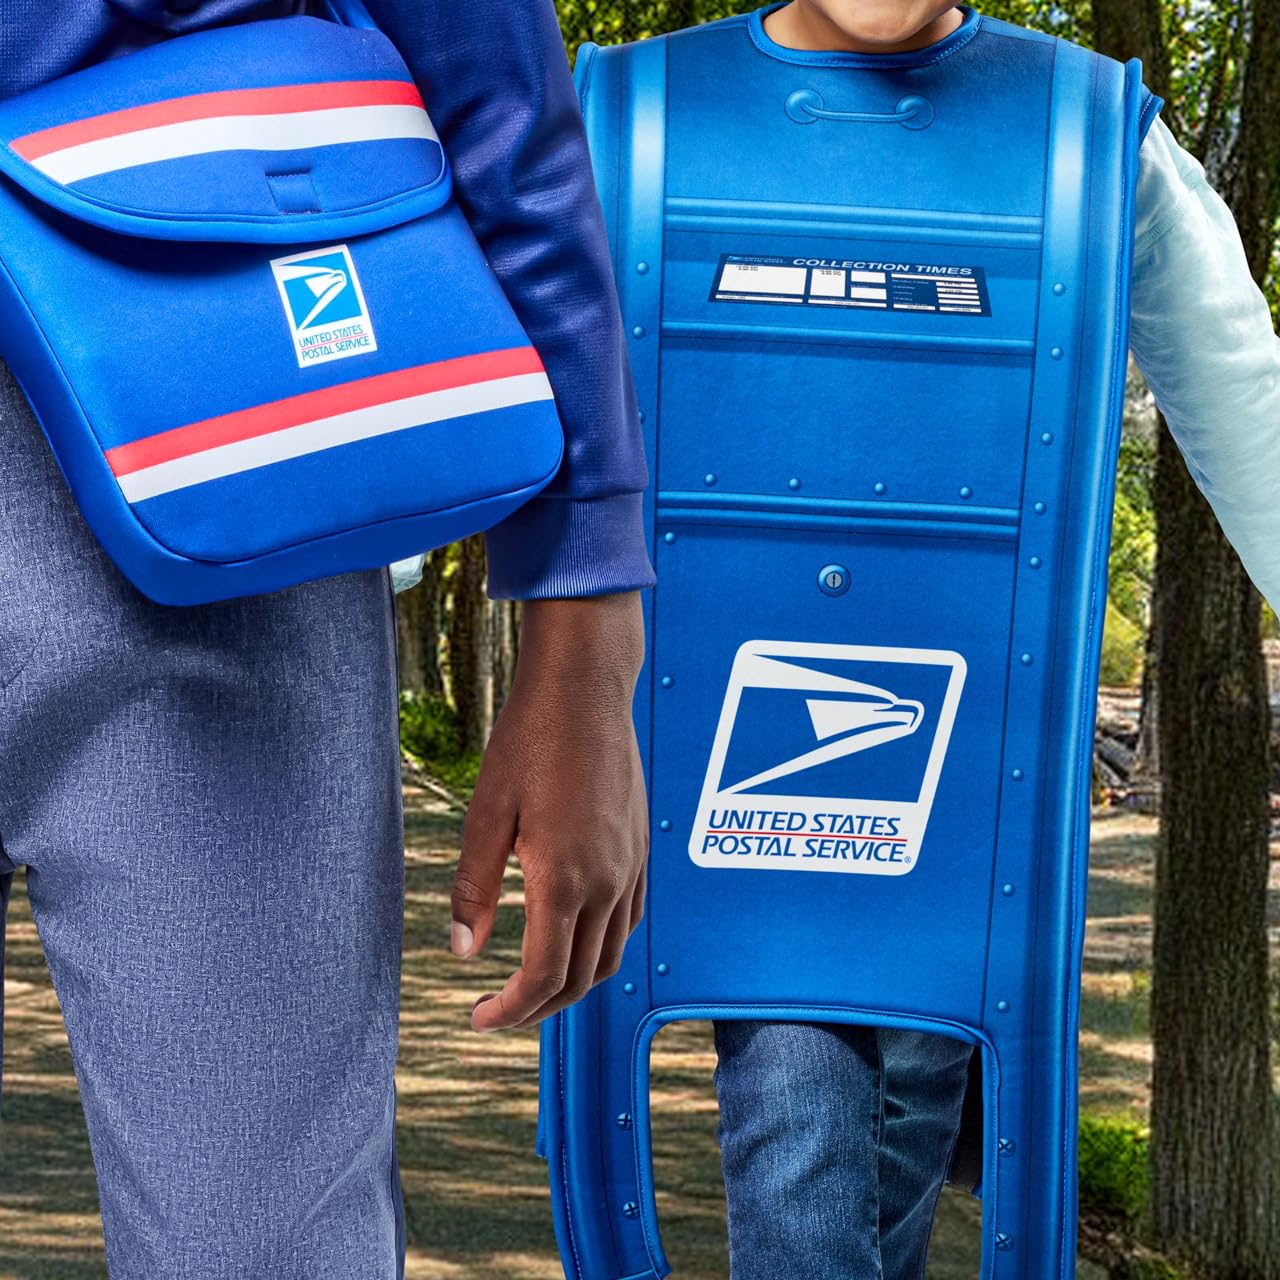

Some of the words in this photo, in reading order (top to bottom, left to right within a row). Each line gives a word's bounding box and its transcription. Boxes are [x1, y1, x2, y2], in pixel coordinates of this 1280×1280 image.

[793, 258, 910, 271] COLLECTION
[915, 265, 972, 275] TIMES
[299, 331, 332, 348] UNITED
[333, 324, 364, 340] STATES
[302, 343, 335, 360] POSTAL
[336, 336, 370, 352] SERVICE
[709, 809, 806, 831] UNITED
[810, 813, 901, 836] STATES
[701, 835, 797, 857] POSTAL
